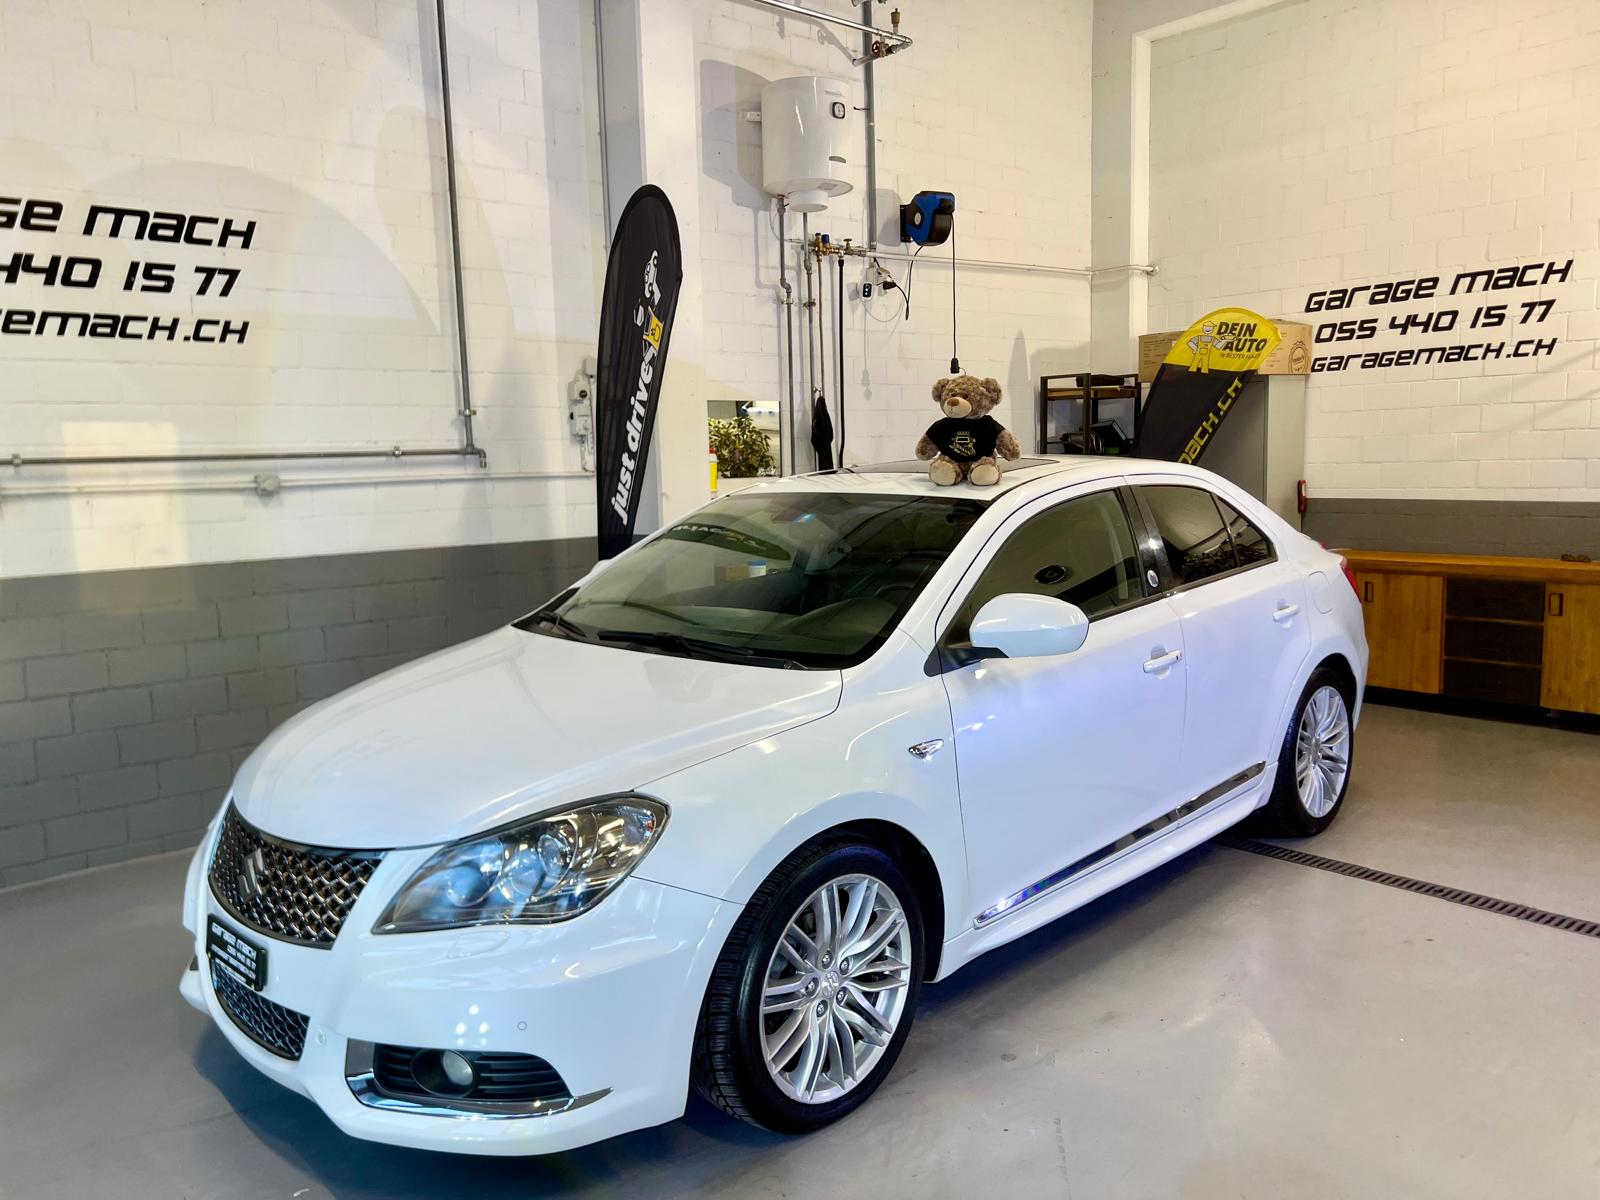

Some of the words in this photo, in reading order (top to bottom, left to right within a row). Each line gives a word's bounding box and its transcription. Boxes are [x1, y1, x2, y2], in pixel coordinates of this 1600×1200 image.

[194, 266, 241, 297] 77
[1216, 321, 1258, 338] DEIN
[1314, 318, 1379, 344] 055
[1389, 309, 1459, 336] 440
[1519, 298, 1557, 324] 77
[1221, 337, 1267, 353] AUTO
[611, 452, 635, 526] just
[626, 360, 653, 453] drive
